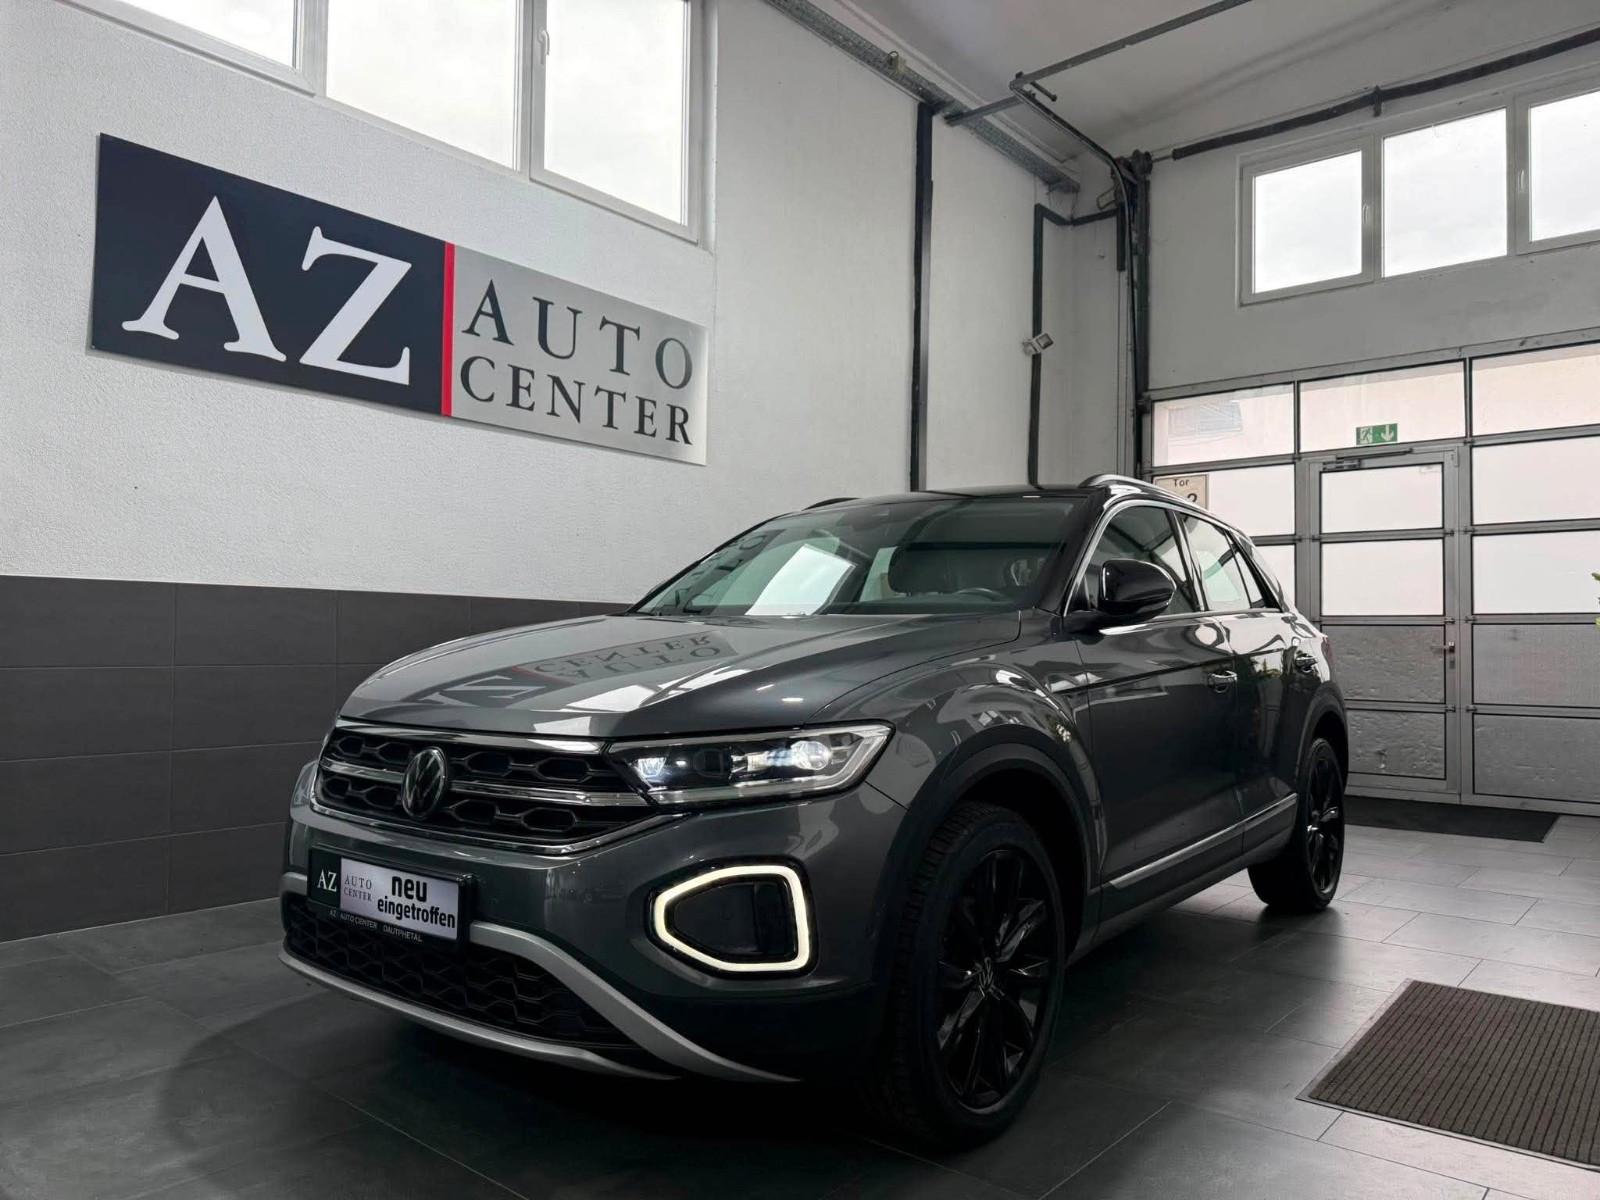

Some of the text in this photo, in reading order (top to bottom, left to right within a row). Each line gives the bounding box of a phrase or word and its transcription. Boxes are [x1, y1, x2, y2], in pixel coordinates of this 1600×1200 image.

[121, 195, 412, 386] AZ
[461, 278, 693, 390] AUTO
[460, 355, 693, 446] CENTER
[1173, 479, 1190, 488] Tor
[316, 869, 338, 893] AZ
[343, 887, 373, 902] CENTER
[344, 875, 373, 890] AUTO
[391, 876, 428, 903] neu
[377, 896, 456, 929] eingetroffen
